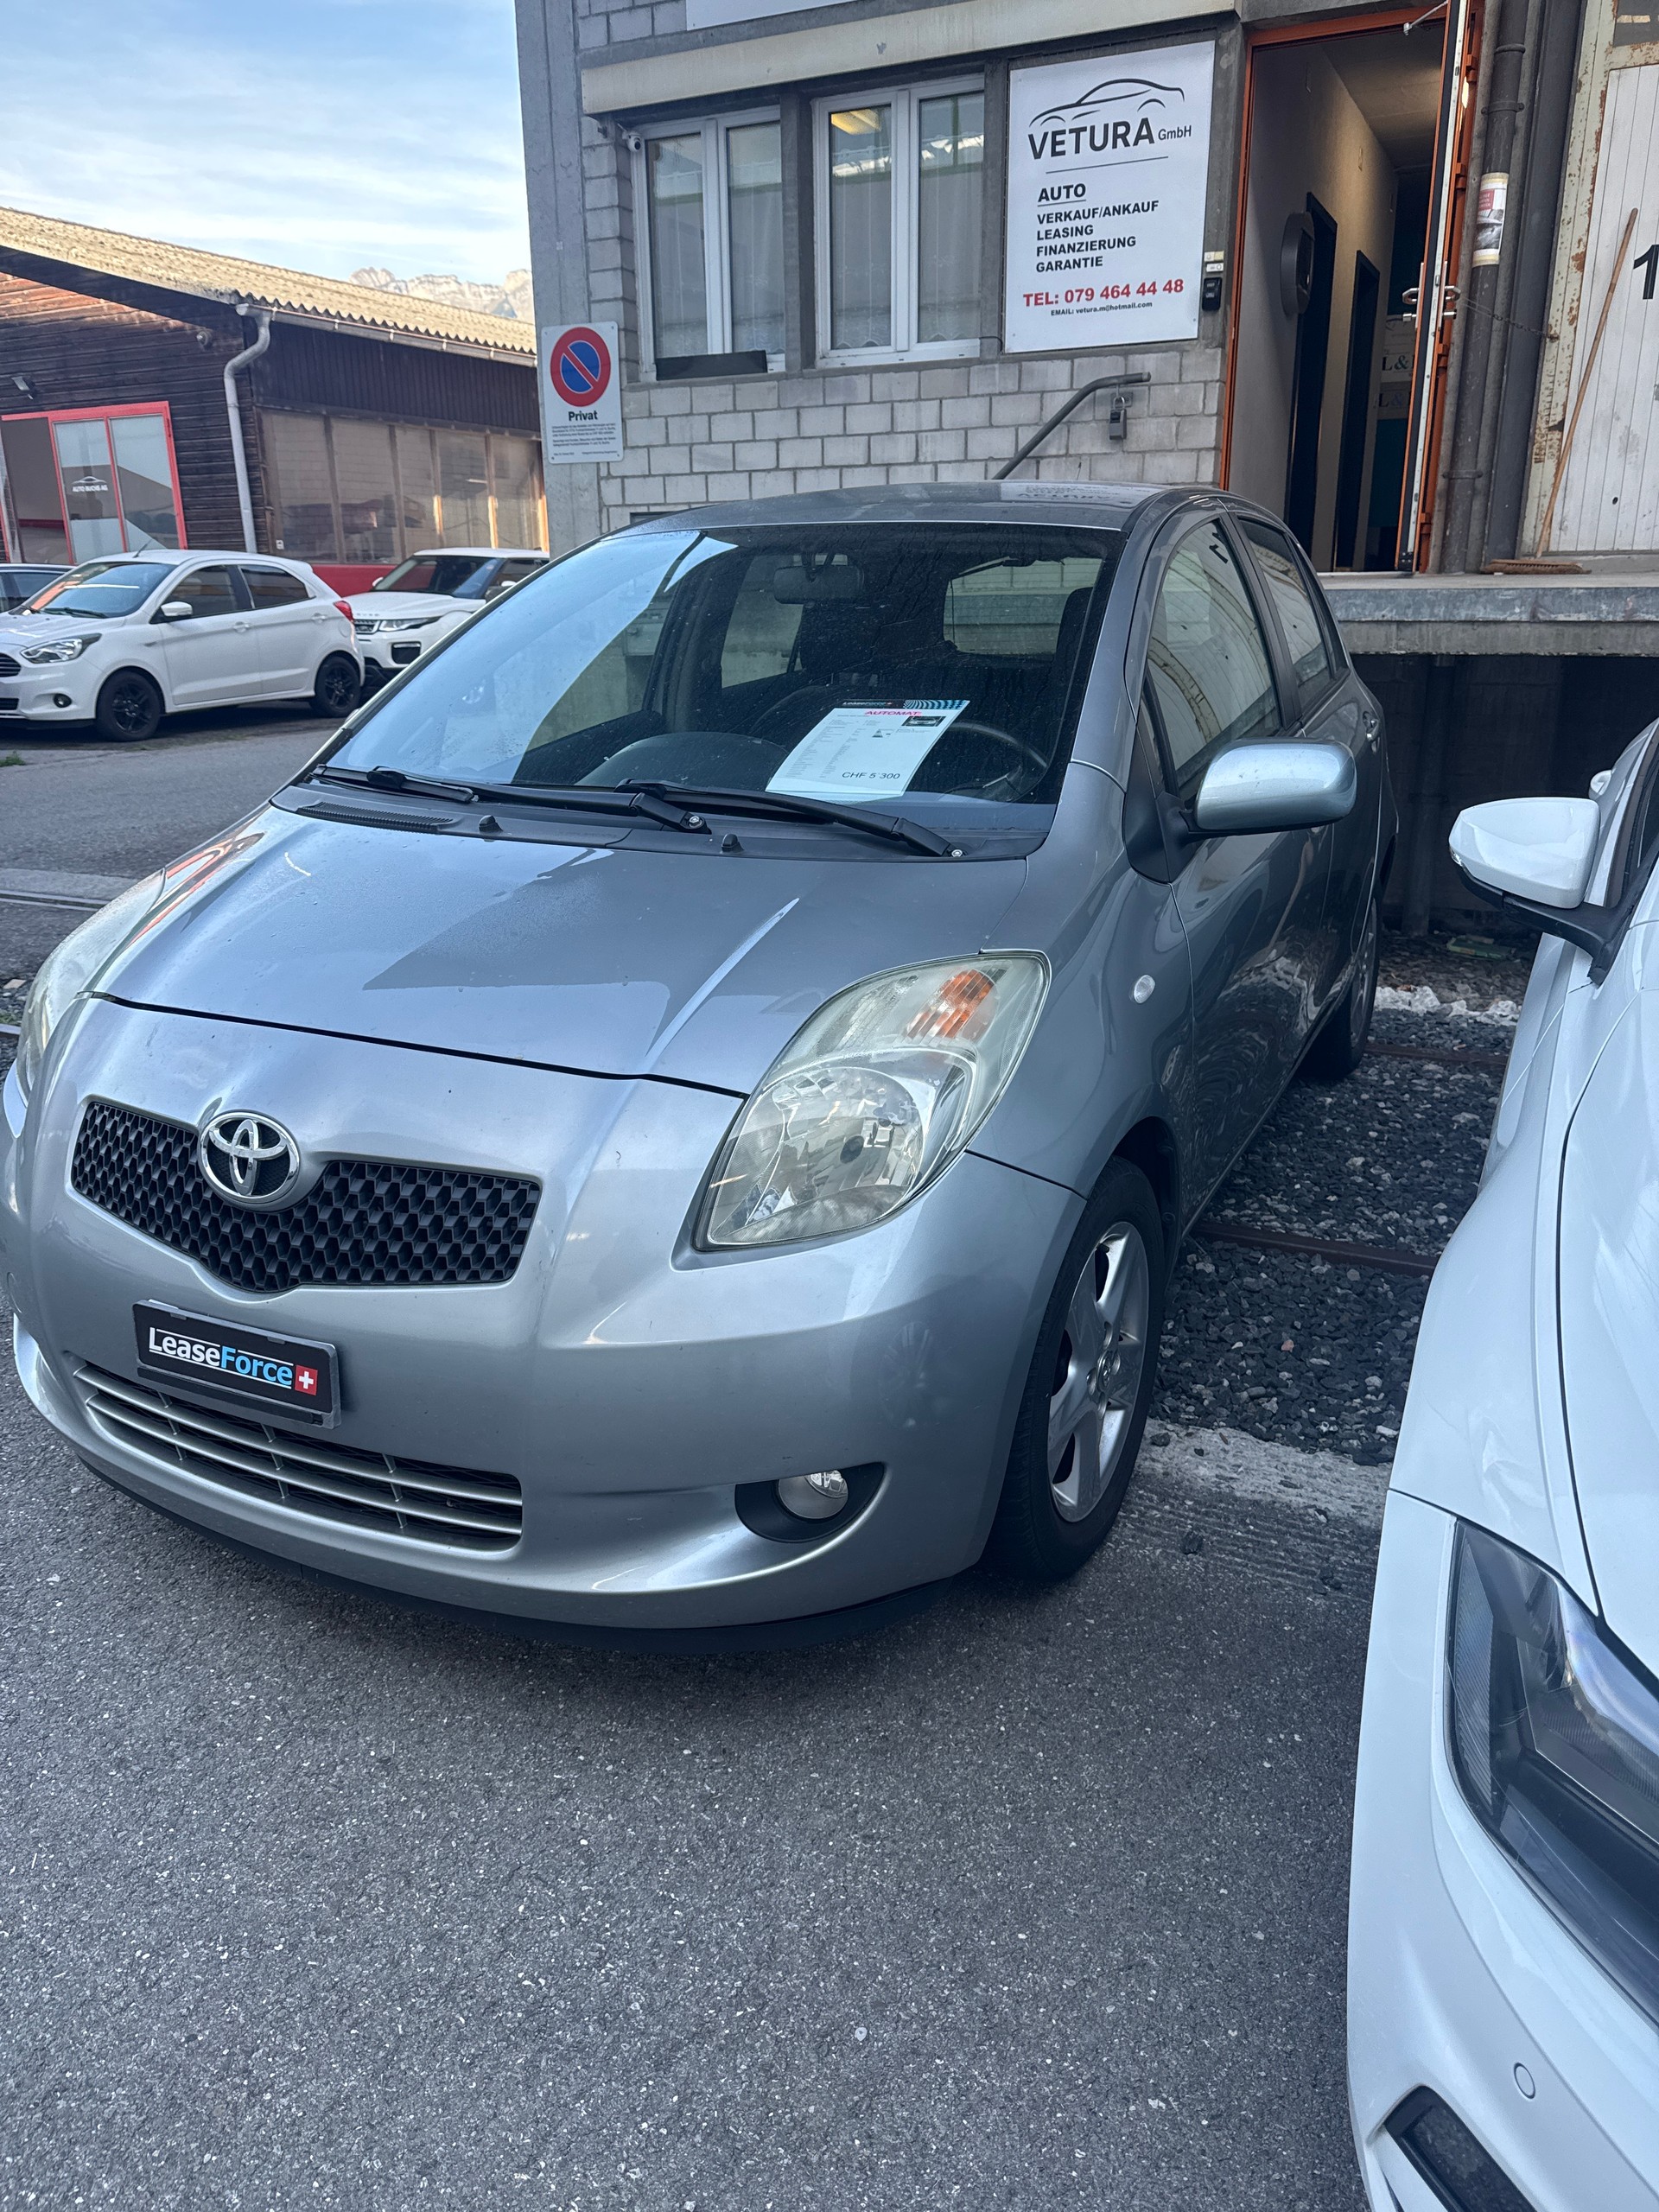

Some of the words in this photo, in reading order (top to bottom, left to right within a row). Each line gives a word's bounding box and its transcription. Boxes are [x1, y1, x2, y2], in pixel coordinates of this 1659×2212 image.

[1028, 118, 1155, 160] VETURA
[1158, 125, 1192, 141] GmbH
[1038, 183, 1086, 202] AUTO
[1037, 200, 1160, 225] VERKAUF/ANKAUF
[1037, 225, 1094, 241] LEASING
[1036, 236, 1136, 257] FINANZIERUNG
[1036, 256, 1103, 273] GARANTIE
[1023, 292, 1059, 308] TEL:
[1065, 288, 1095, 303] 079
[1100, 284, 1131, 301] 464
[1136, 281, 1158, 296] 44
[1162, 279, 1184, 294] 48
[1051, 308, 1075, 316] EMAIL:
[1075, 302, 1153, 315] vetura.m@hotmail.com
[568, 410, 598, 422] Privat
[149, 1326, 293, 1386] LeaseForce
